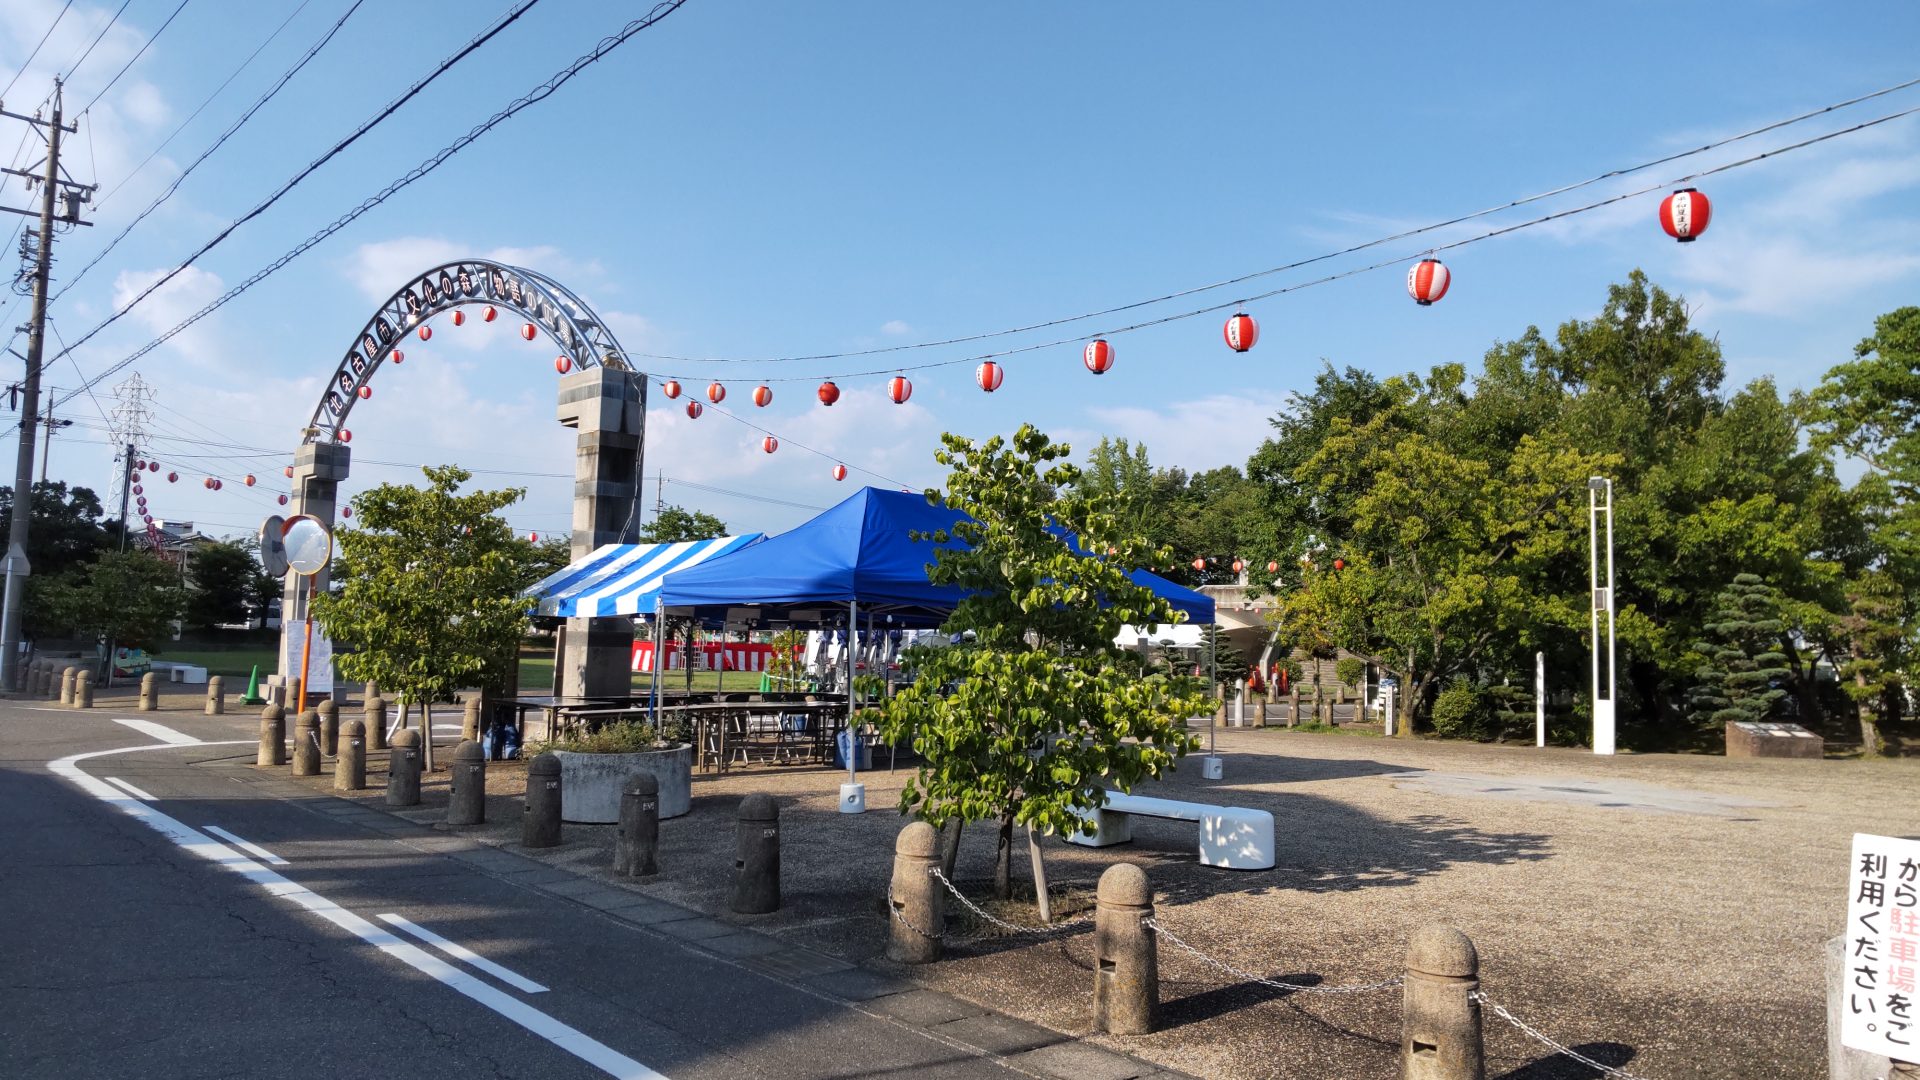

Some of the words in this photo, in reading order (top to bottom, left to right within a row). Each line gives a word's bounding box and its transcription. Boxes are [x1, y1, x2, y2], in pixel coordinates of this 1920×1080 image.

[329, 321, 392, 414] 北名古屋市
[406, 271, 472, 315] 文化の森
[493, 272, 570, 345] 物語の広場
[1851, 853, 1887, 1032] 利用ください。
[1885, 857, 1920, 1046] から駐車場をご
